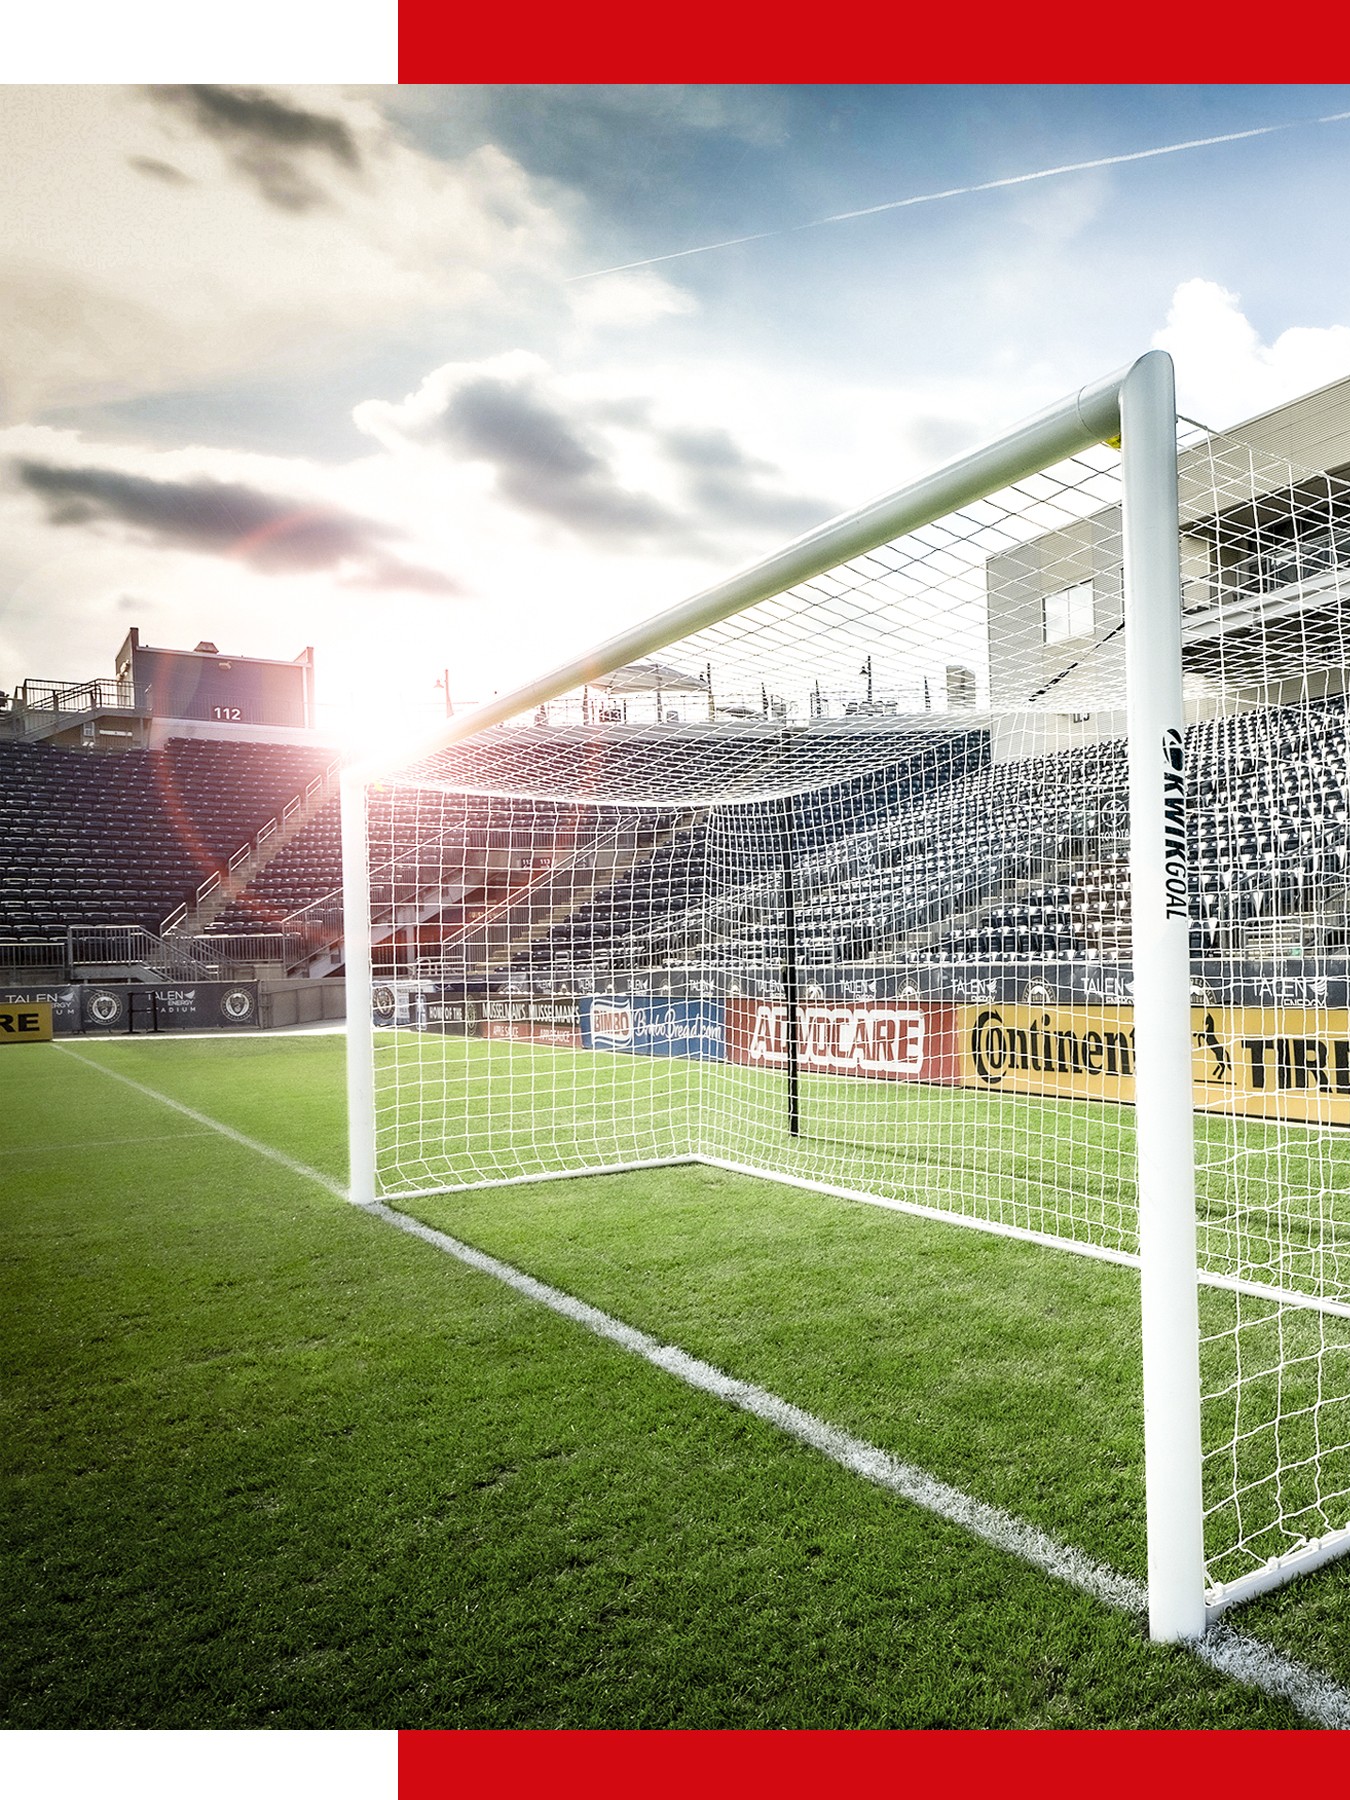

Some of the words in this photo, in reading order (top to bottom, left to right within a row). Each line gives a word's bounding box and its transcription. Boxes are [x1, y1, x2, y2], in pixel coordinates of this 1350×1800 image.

[214, 706, 242, 721] 112
[951, 979, 986, 994] TALEN
[1081, 977, 1124, 996] TALEN
[1251, 978, 1307, 997] TALEN
[594, 1010, 629, 1036] BIMBO
[751, 1006, 925, 1073] ADVOCARE
